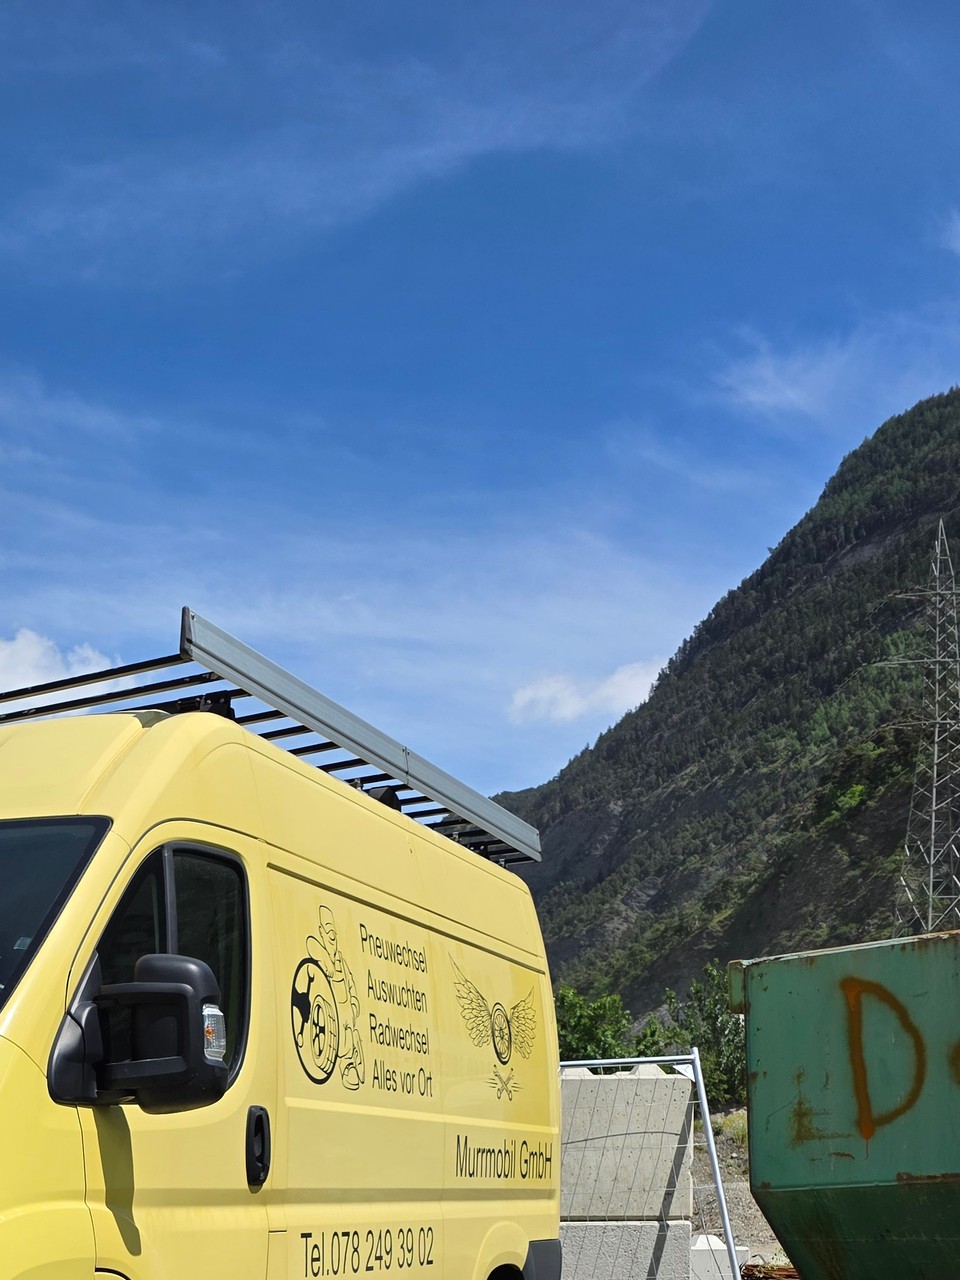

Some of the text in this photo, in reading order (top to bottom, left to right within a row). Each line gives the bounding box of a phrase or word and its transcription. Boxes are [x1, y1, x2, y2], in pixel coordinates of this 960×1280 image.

[359, 923, 428, 973] Pneuwechsel
[367, 969, 428, 1013] Auswuchten
[369, 1012, 429, 1056] Radwechsel
[372, 1059, 398, 1092] Alles
[400, 1073, 416, 1095] vor
[418, 1067, 433, 1098] Ort
[455, 1134, 553, 1180] Murrmobil GmbH
[365, 1228, 393, 1272] 249
[397, 1228, 414, 1269] 39
[418, 1226, 434, 1267] 02
